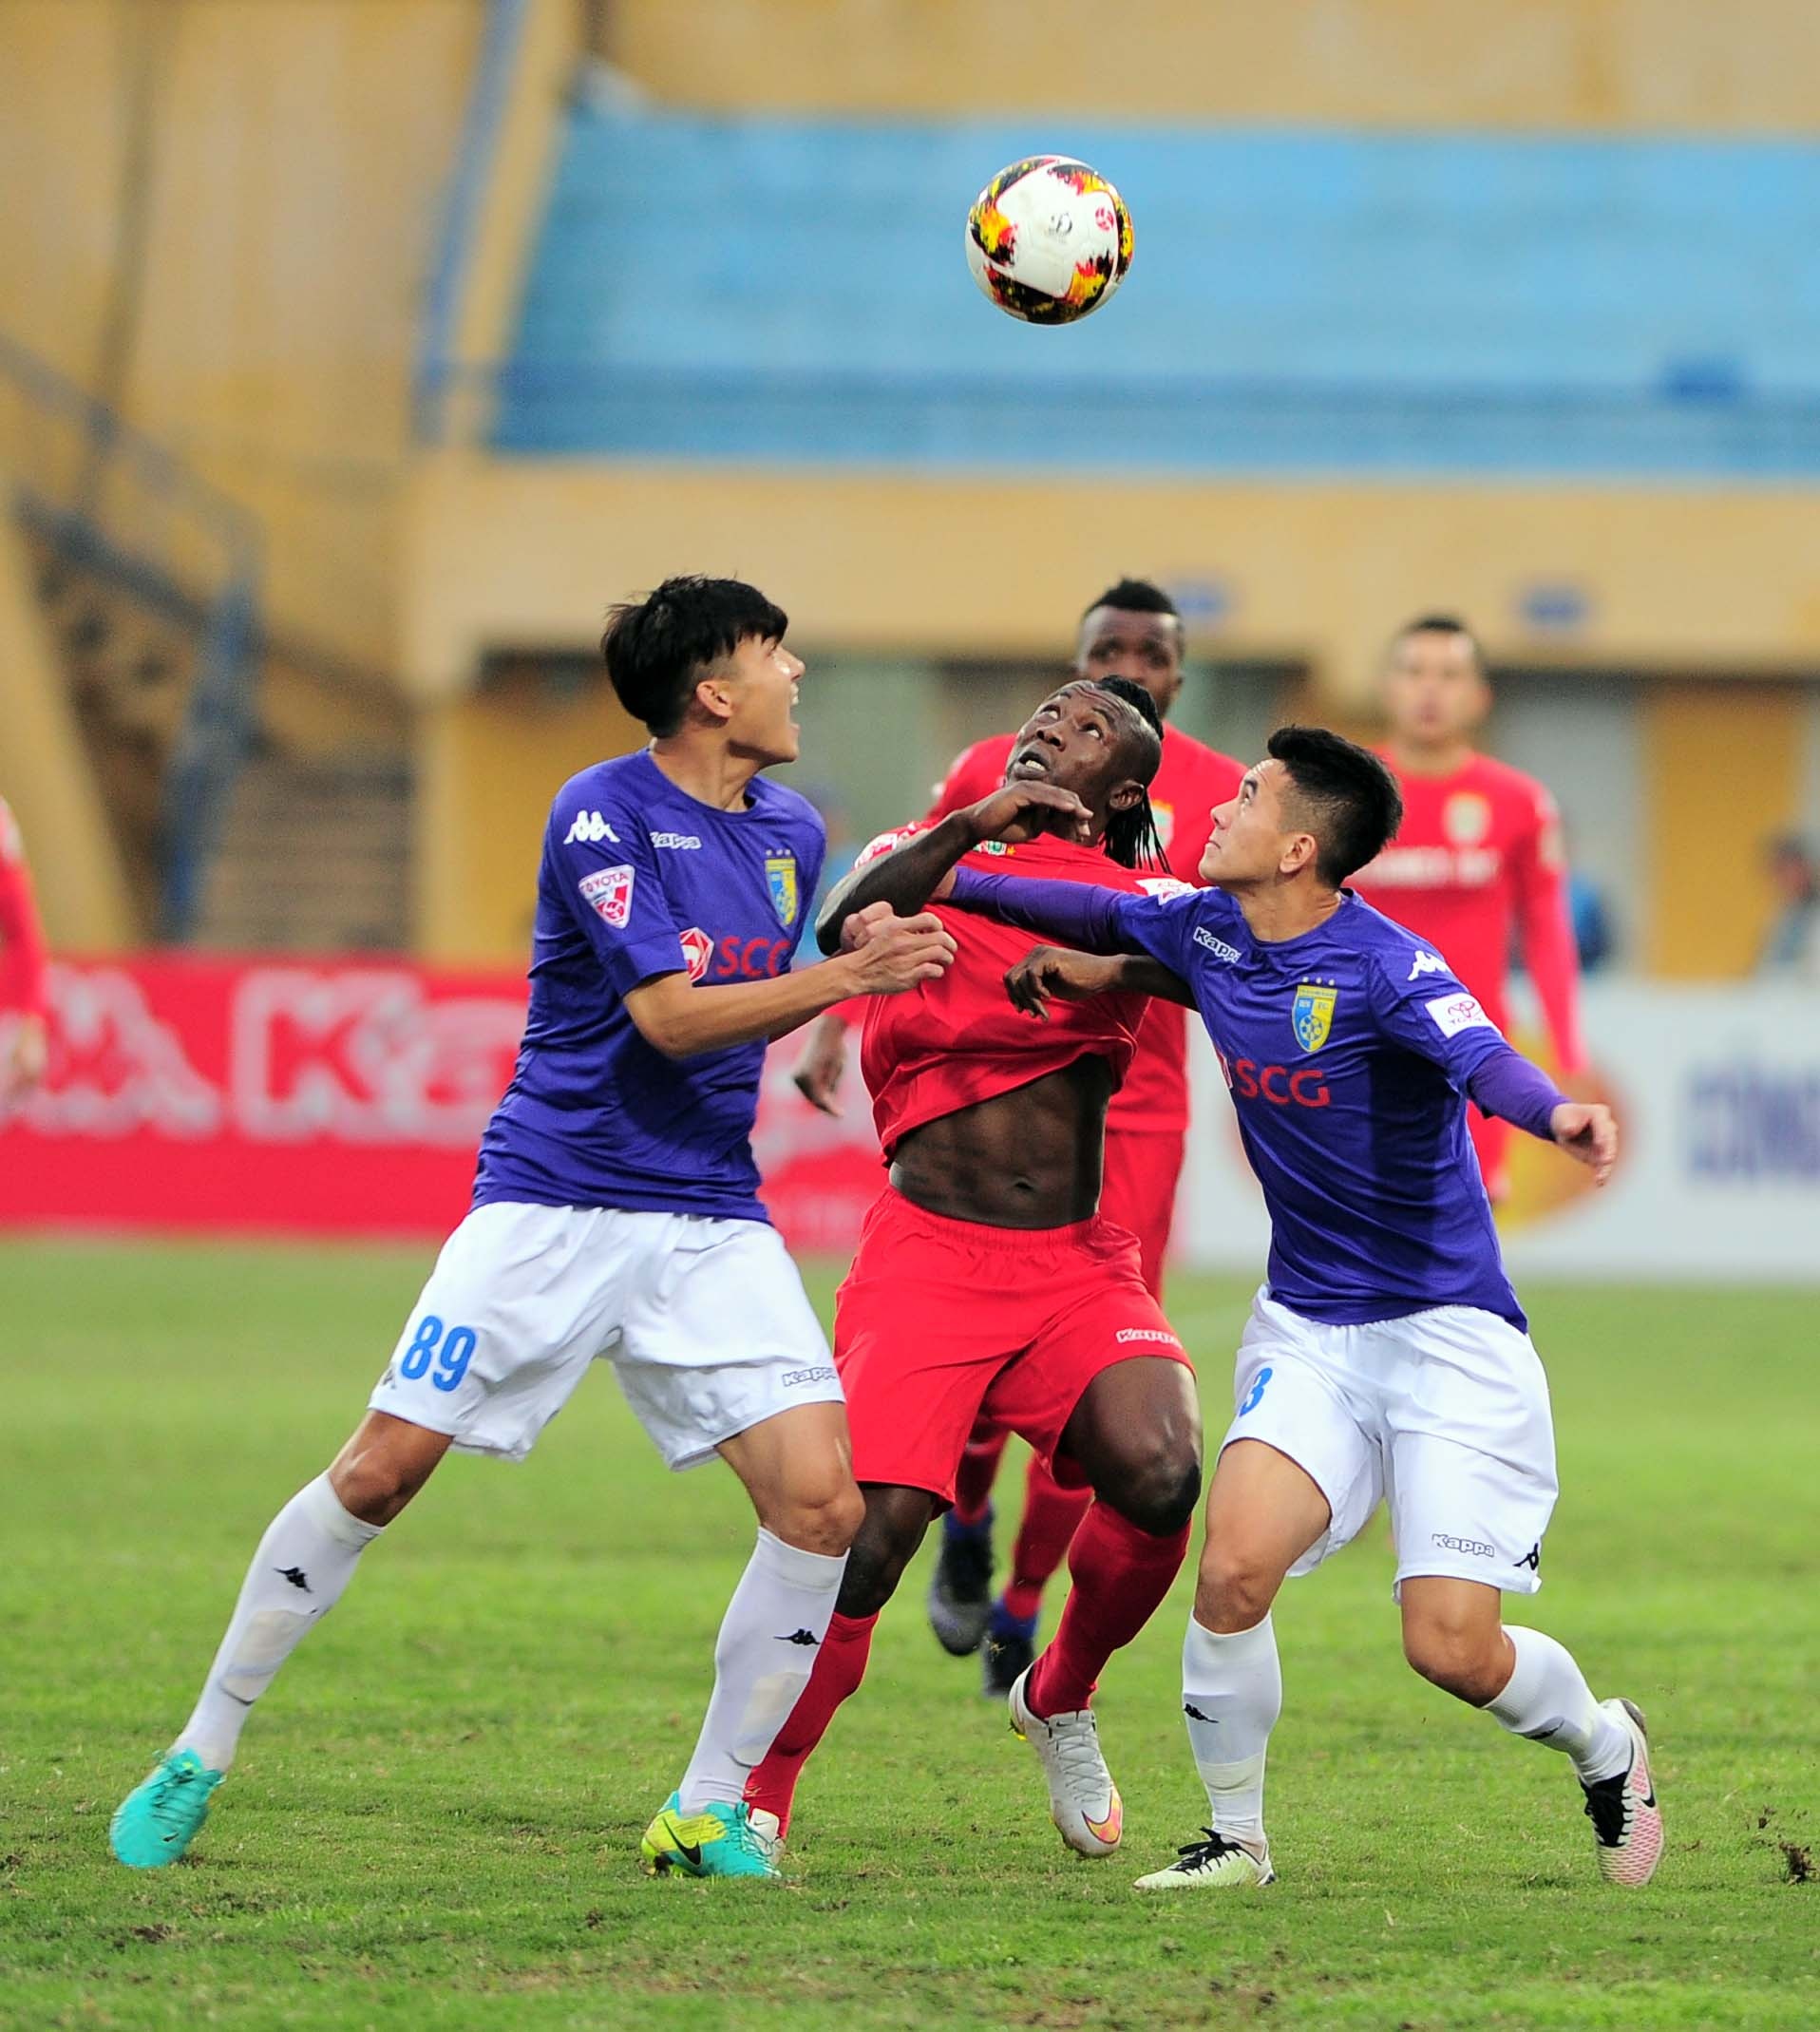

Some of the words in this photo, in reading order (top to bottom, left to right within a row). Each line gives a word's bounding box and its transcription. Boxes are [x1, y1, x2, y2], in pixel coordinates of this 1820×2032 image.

[1236, 1057, 1331, 1108] SCG
[401, 1316, 477, 1392] 89
[1431, 1533, 1495, 1558] Kappa
